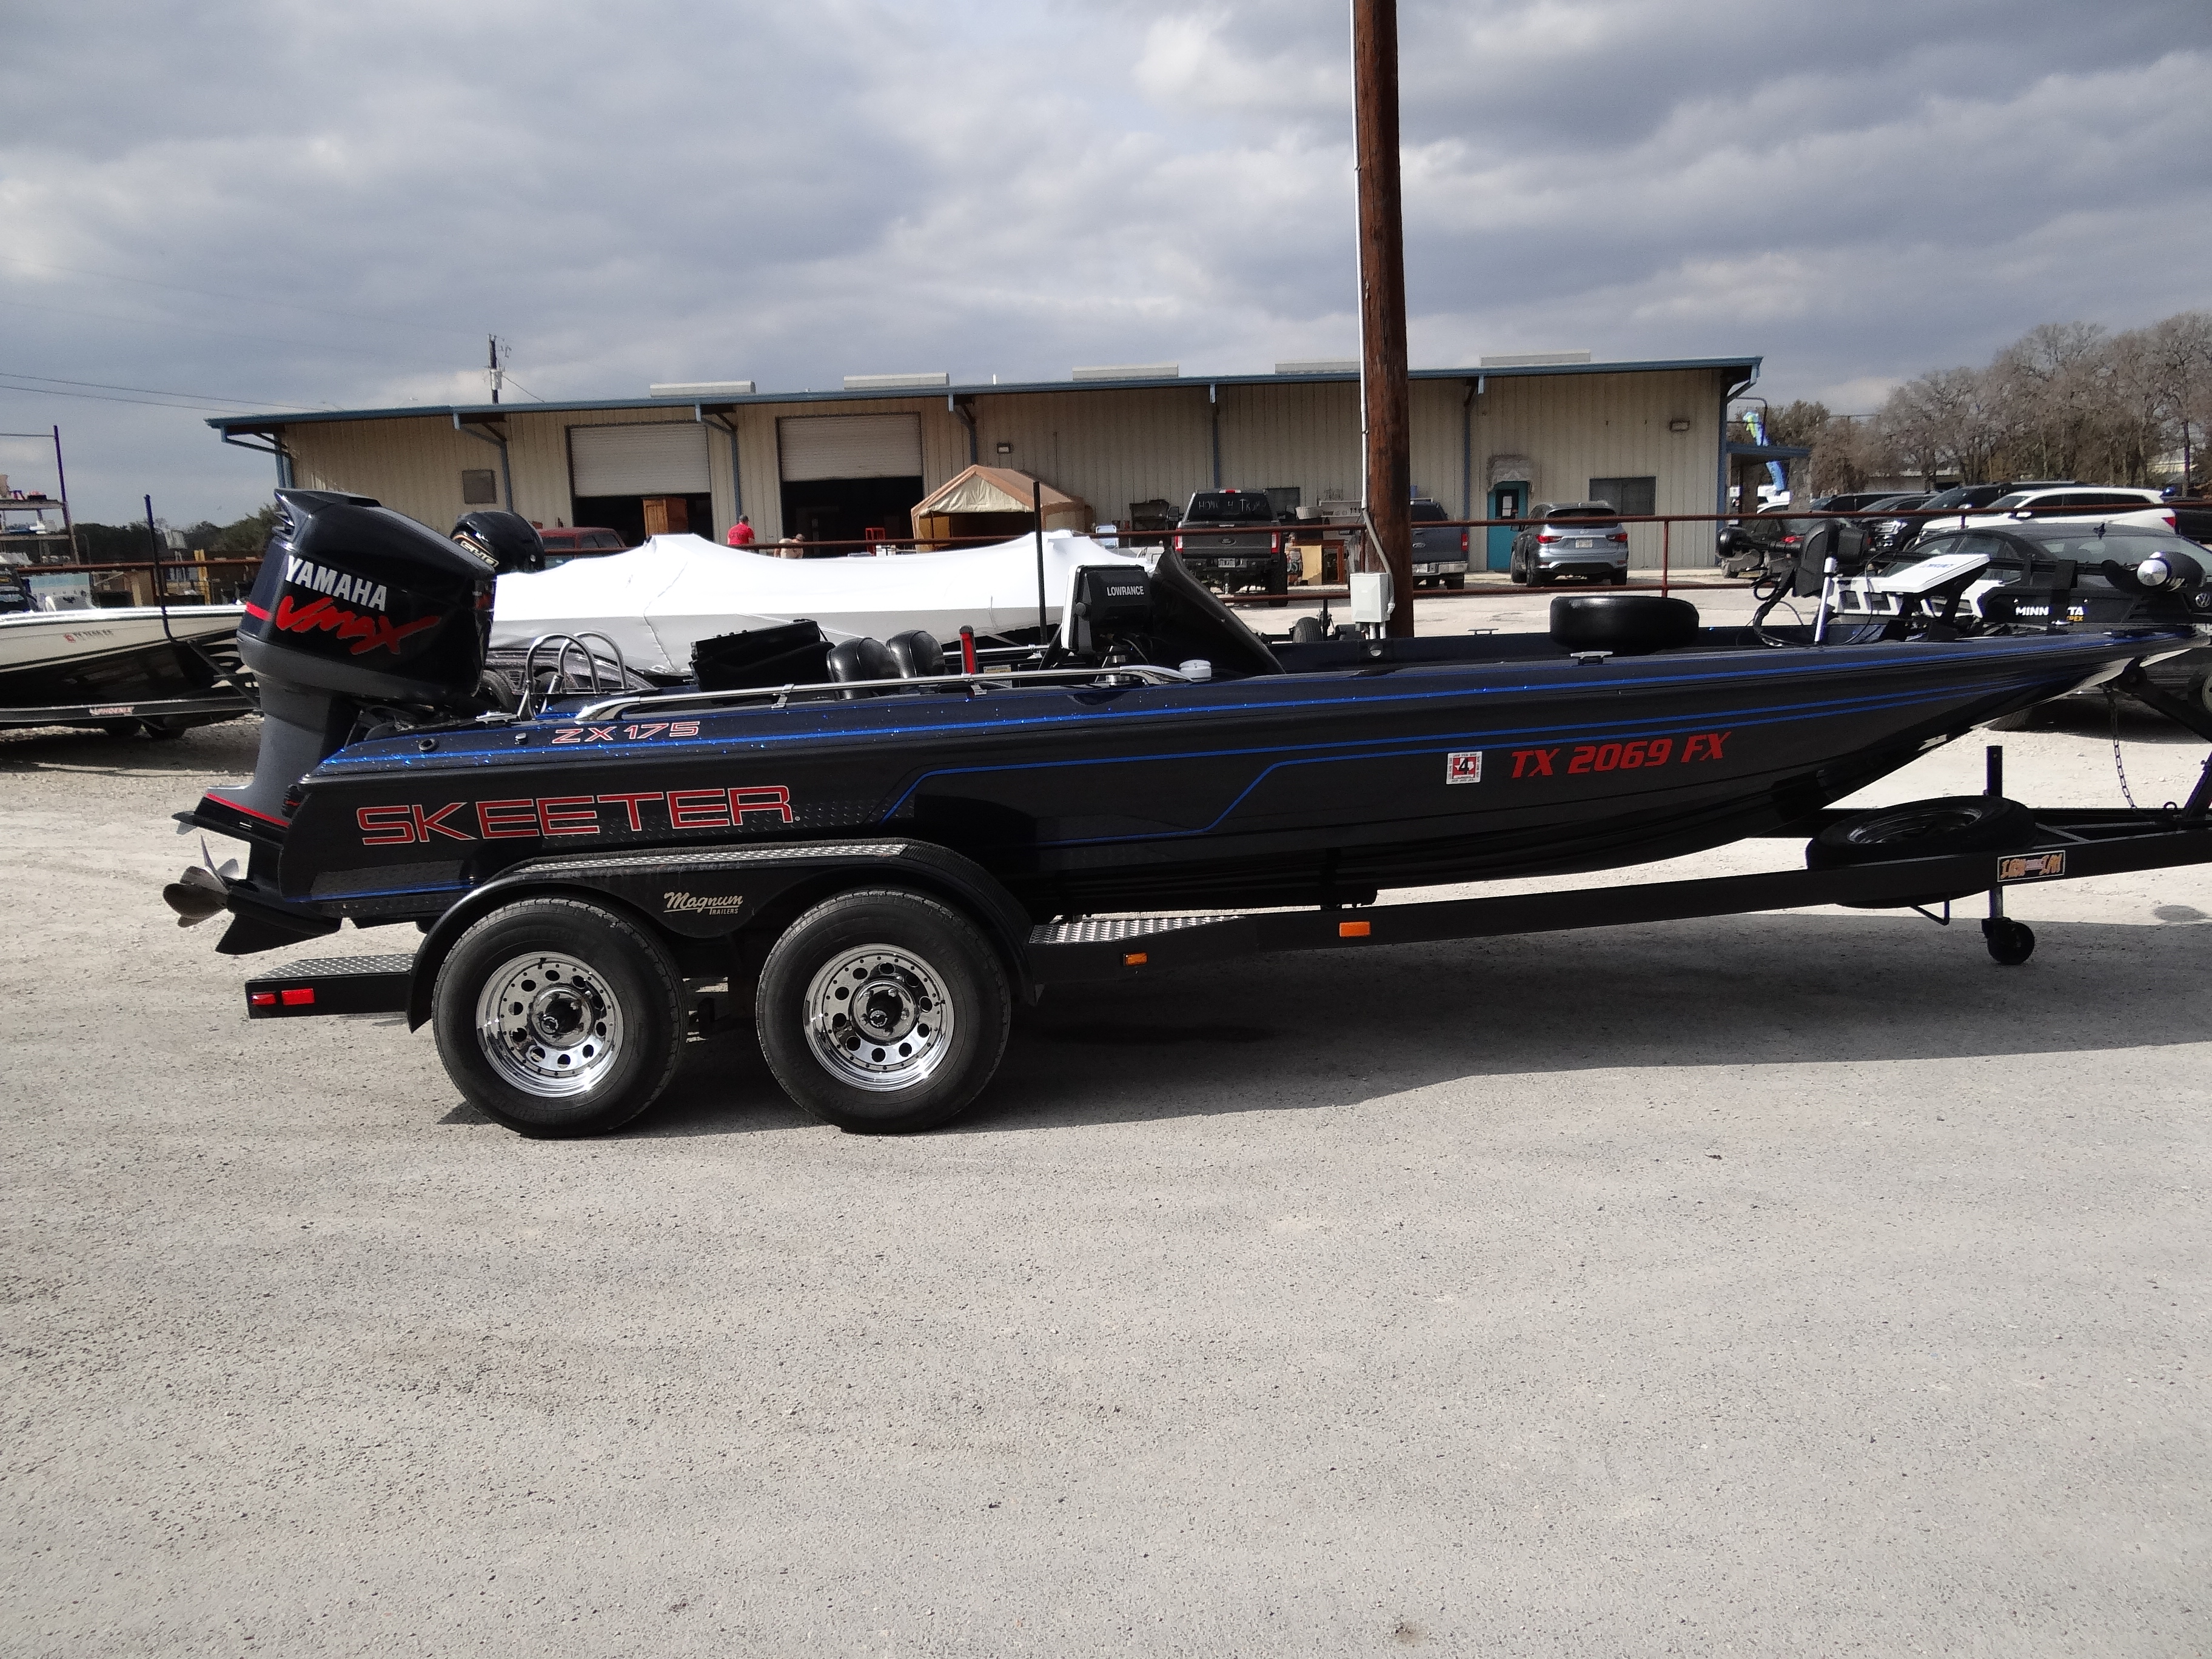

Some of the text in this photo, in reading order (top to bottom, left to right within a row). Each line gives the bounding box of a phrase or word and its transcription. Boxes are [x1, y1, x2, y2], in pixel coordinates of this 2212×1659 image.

[284, 554, 387, 612] YAMAHA
[1107, 585, 1144, 596] LOWRANCE
[2016, 606, 2084, 615] MINN TA
[551, 721, 700, 744] ZX 175
[1510, 746, 1561, 779] TX
[1566, 737, 1674, 775] 2069
[1680, 731, 1732, 763] FX
[1459, 758, 1469, 775] 4
[356, 785, 794, 845] SKEETER
[663, 891, 743, 913] Magnum
